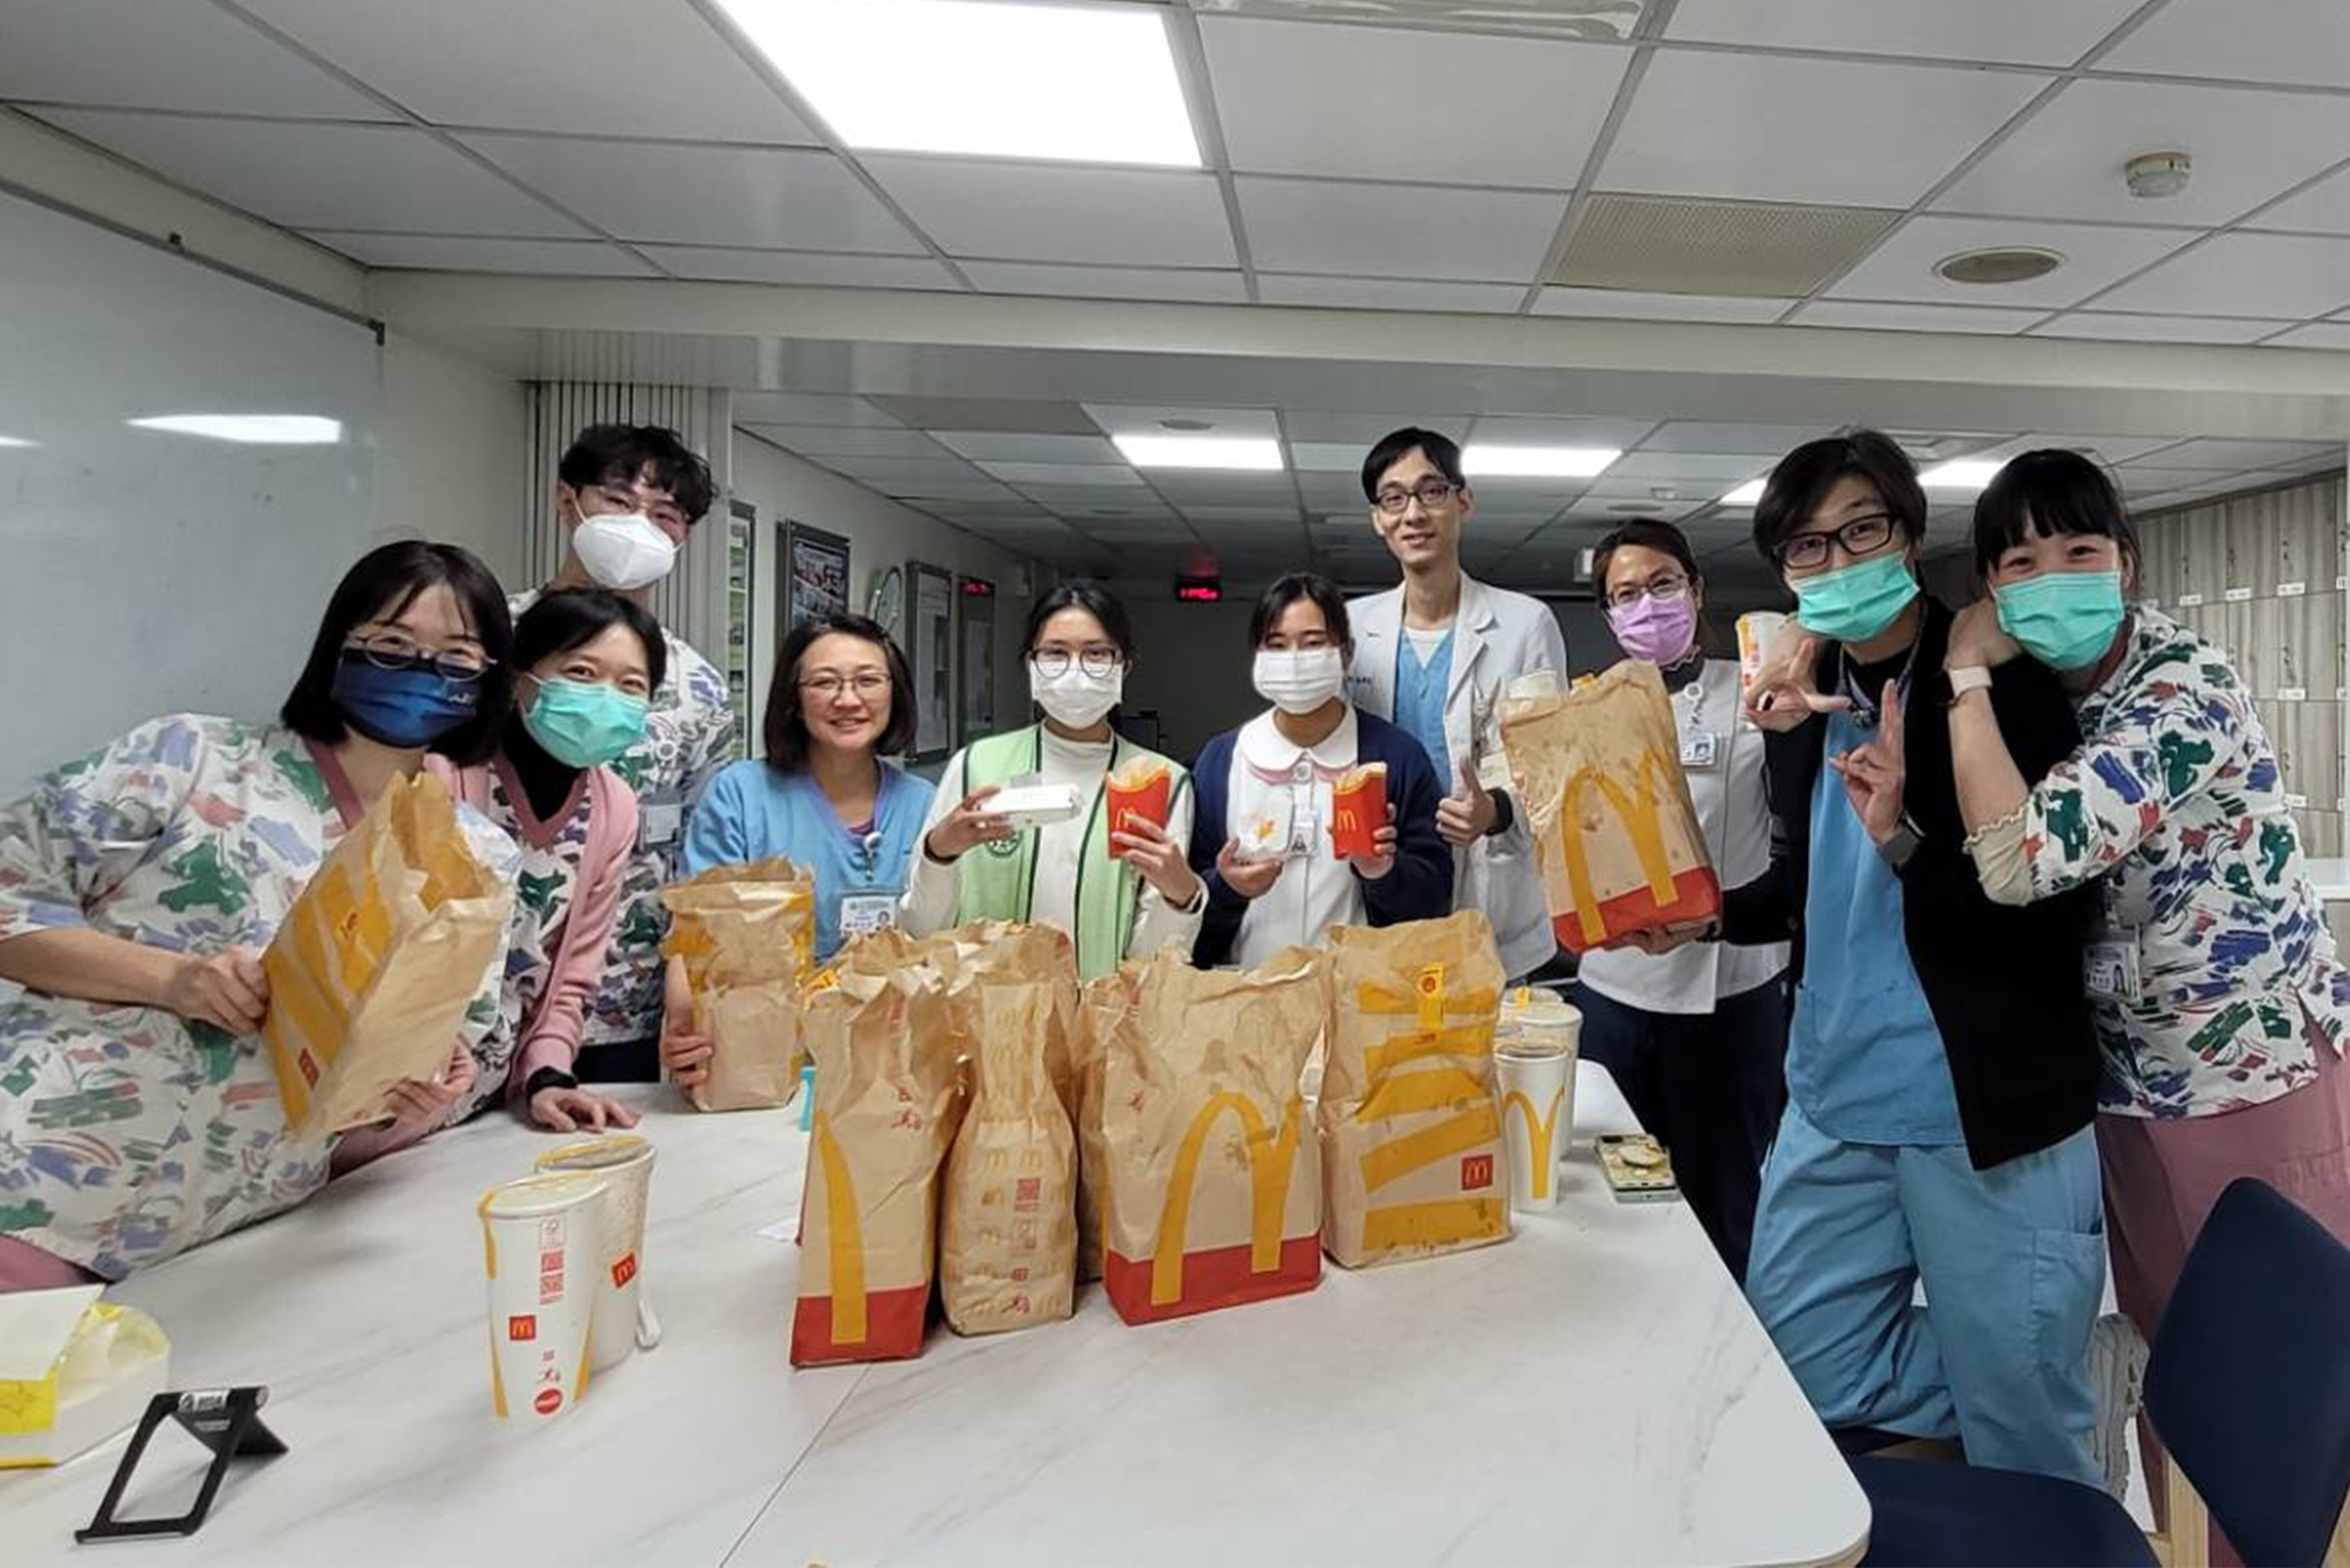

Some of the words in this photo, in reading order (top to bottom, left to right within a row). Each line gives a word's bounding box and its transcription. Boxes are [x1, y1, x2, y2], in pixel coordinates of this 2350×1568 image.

[1338, 810, 1357, 831] M
[1465, 1160, 1488, 1184] M
[513, 1319, 533, 1337] M
